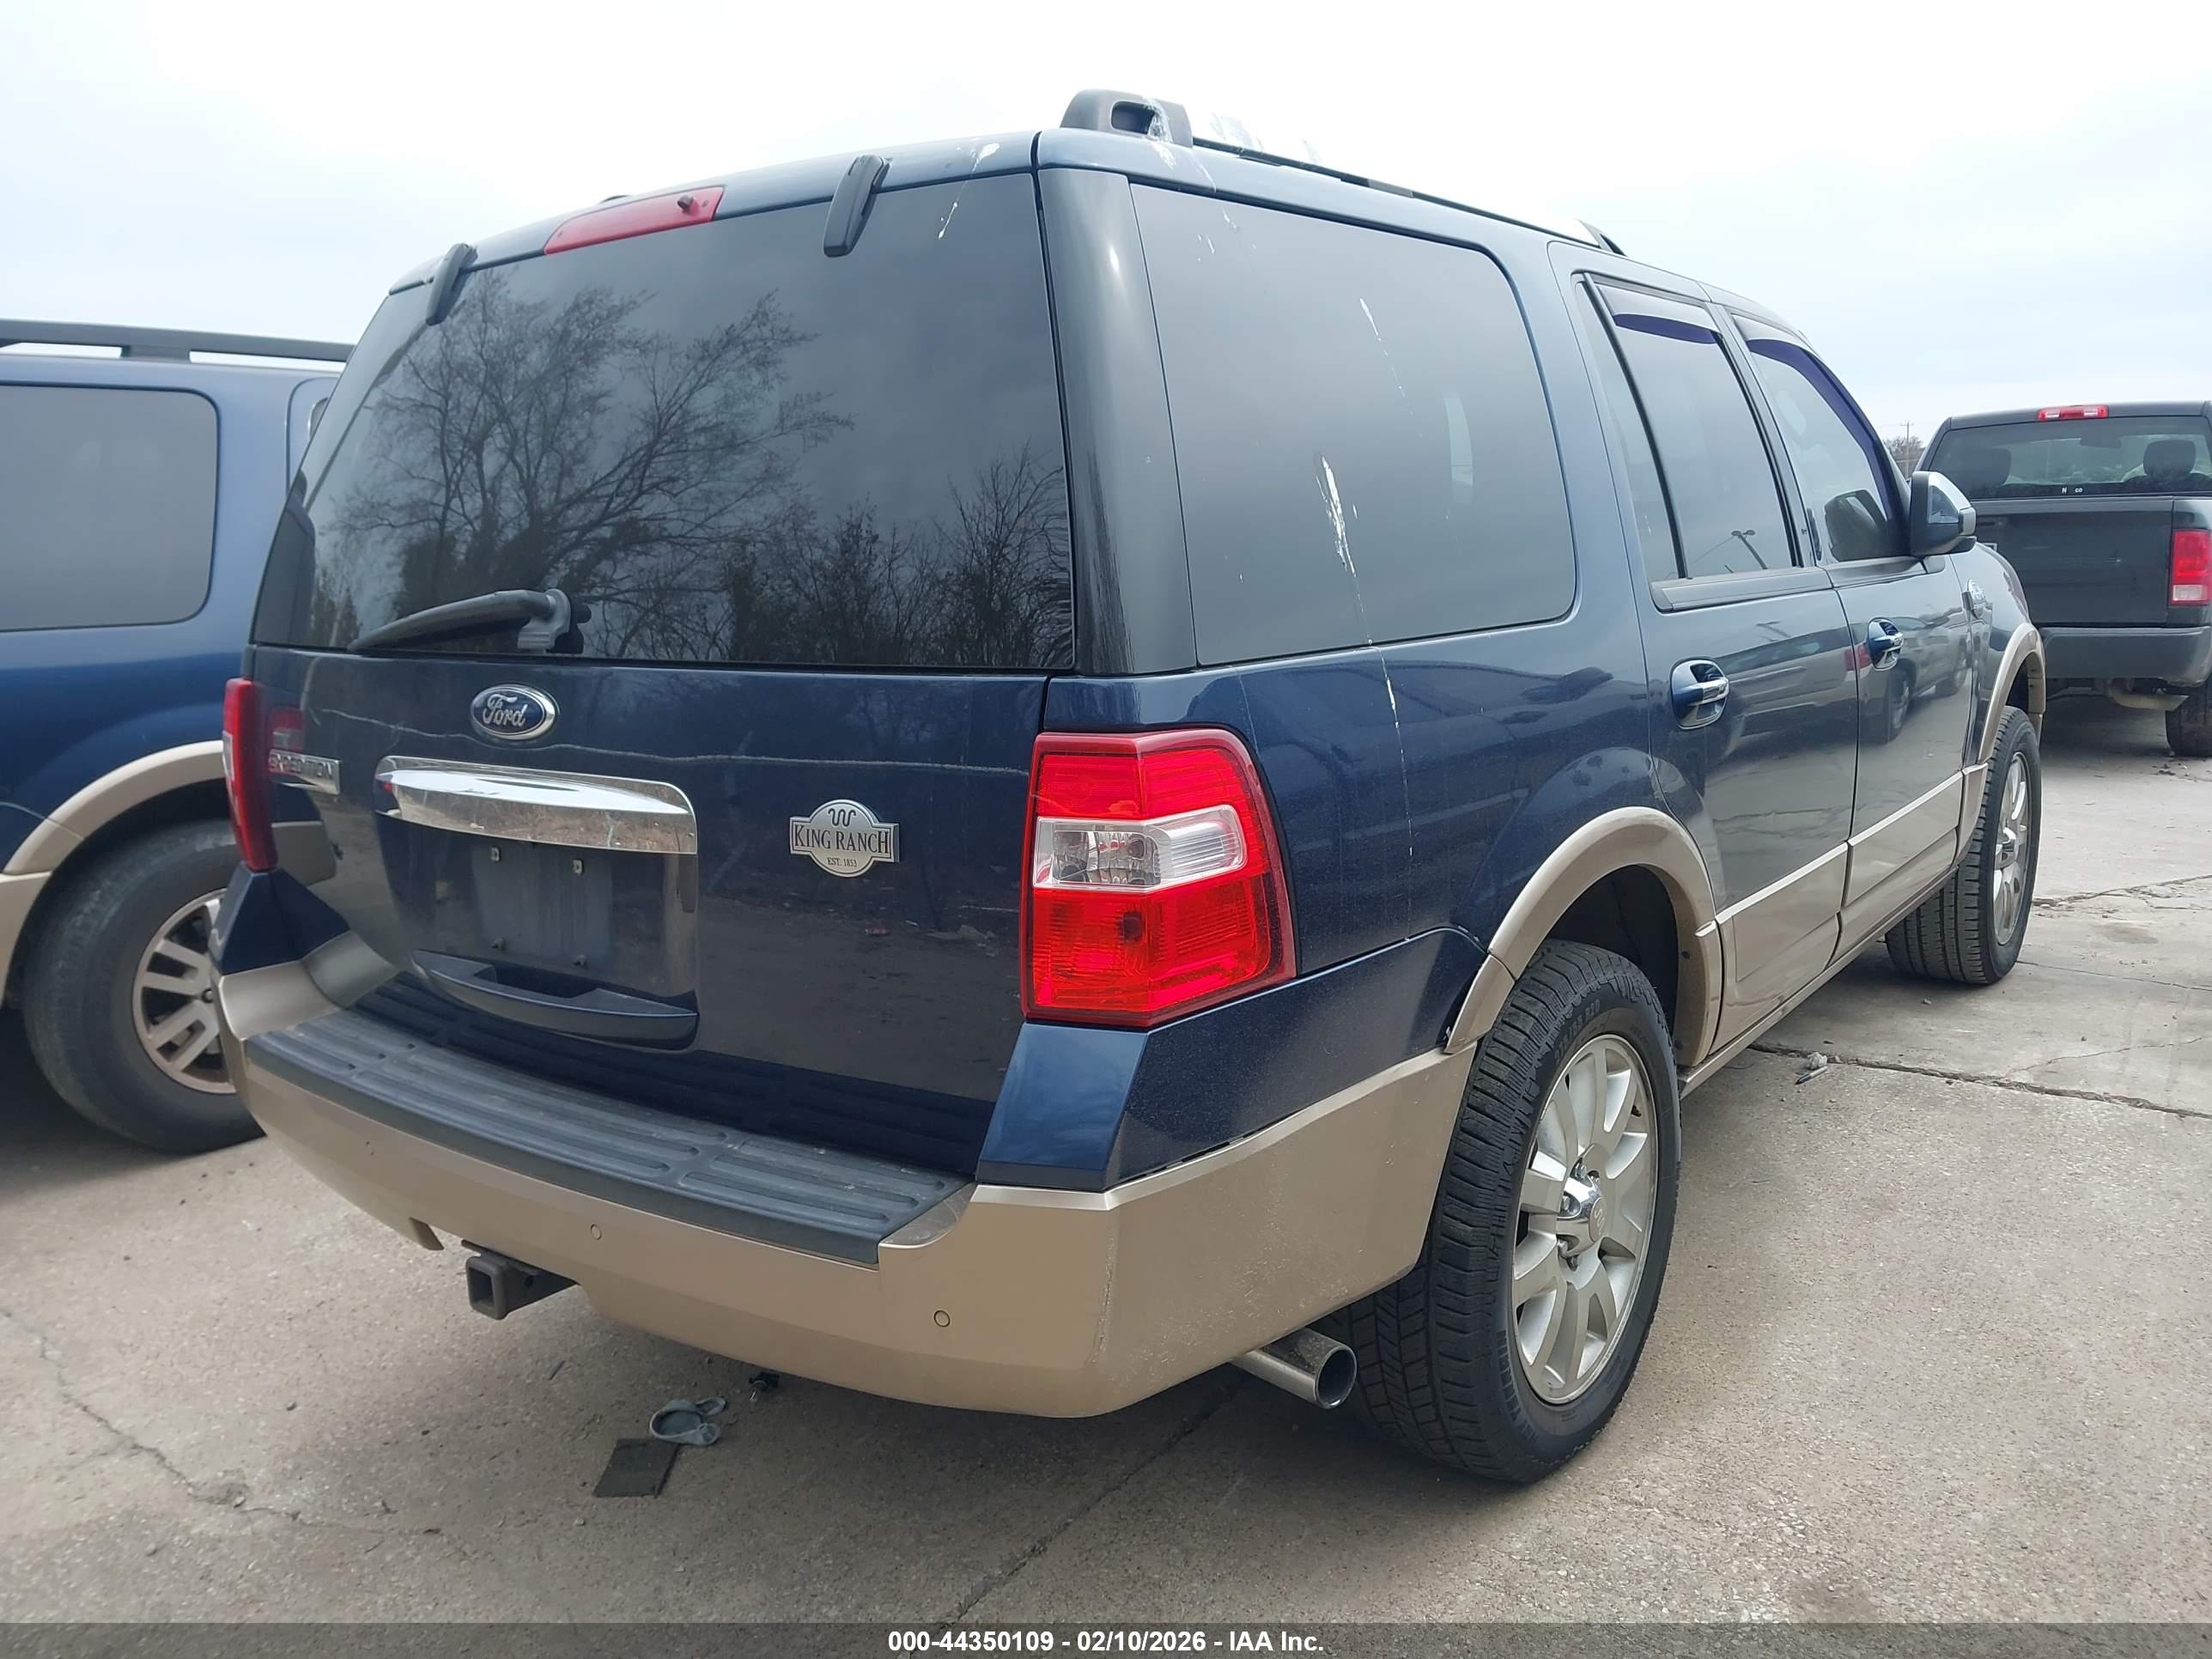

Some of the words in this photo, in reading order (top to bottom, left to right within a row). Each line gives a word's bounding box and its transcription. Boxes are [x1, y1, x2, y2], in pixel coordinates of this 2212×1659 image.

[483, 693, 529, 727] Ford
[268, 752, 335, 780] EXPEDITION
[794, 823, 830, 849] KING
[836, 830, 889, 854] RANCH
[827, 857, 842, 866] EST.
[843, 859, 857, 867] 1853
